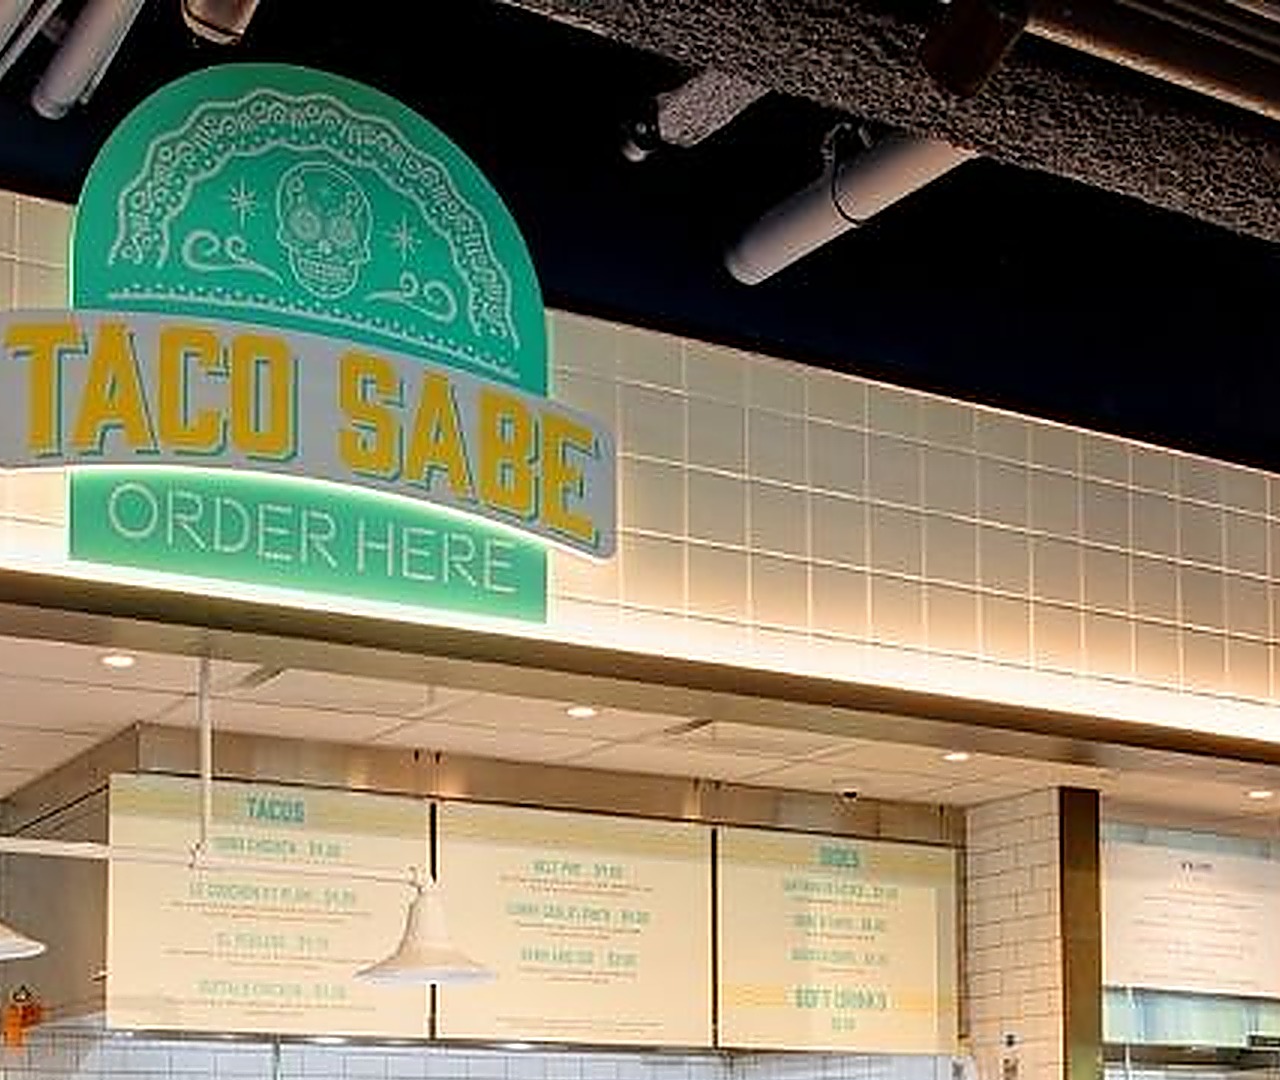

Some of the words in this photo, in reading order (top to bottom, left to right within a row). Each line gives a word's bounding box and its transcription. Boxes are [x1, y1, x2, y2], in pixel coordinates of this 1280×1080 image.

[5, 318, 298, 461] TACO
[336, 350, 604, 550] SABE
[107, 481, 337, 566] ORDER
[357, 521, 517, 594] HERE
[247, 797, 305, 822] TACOS
